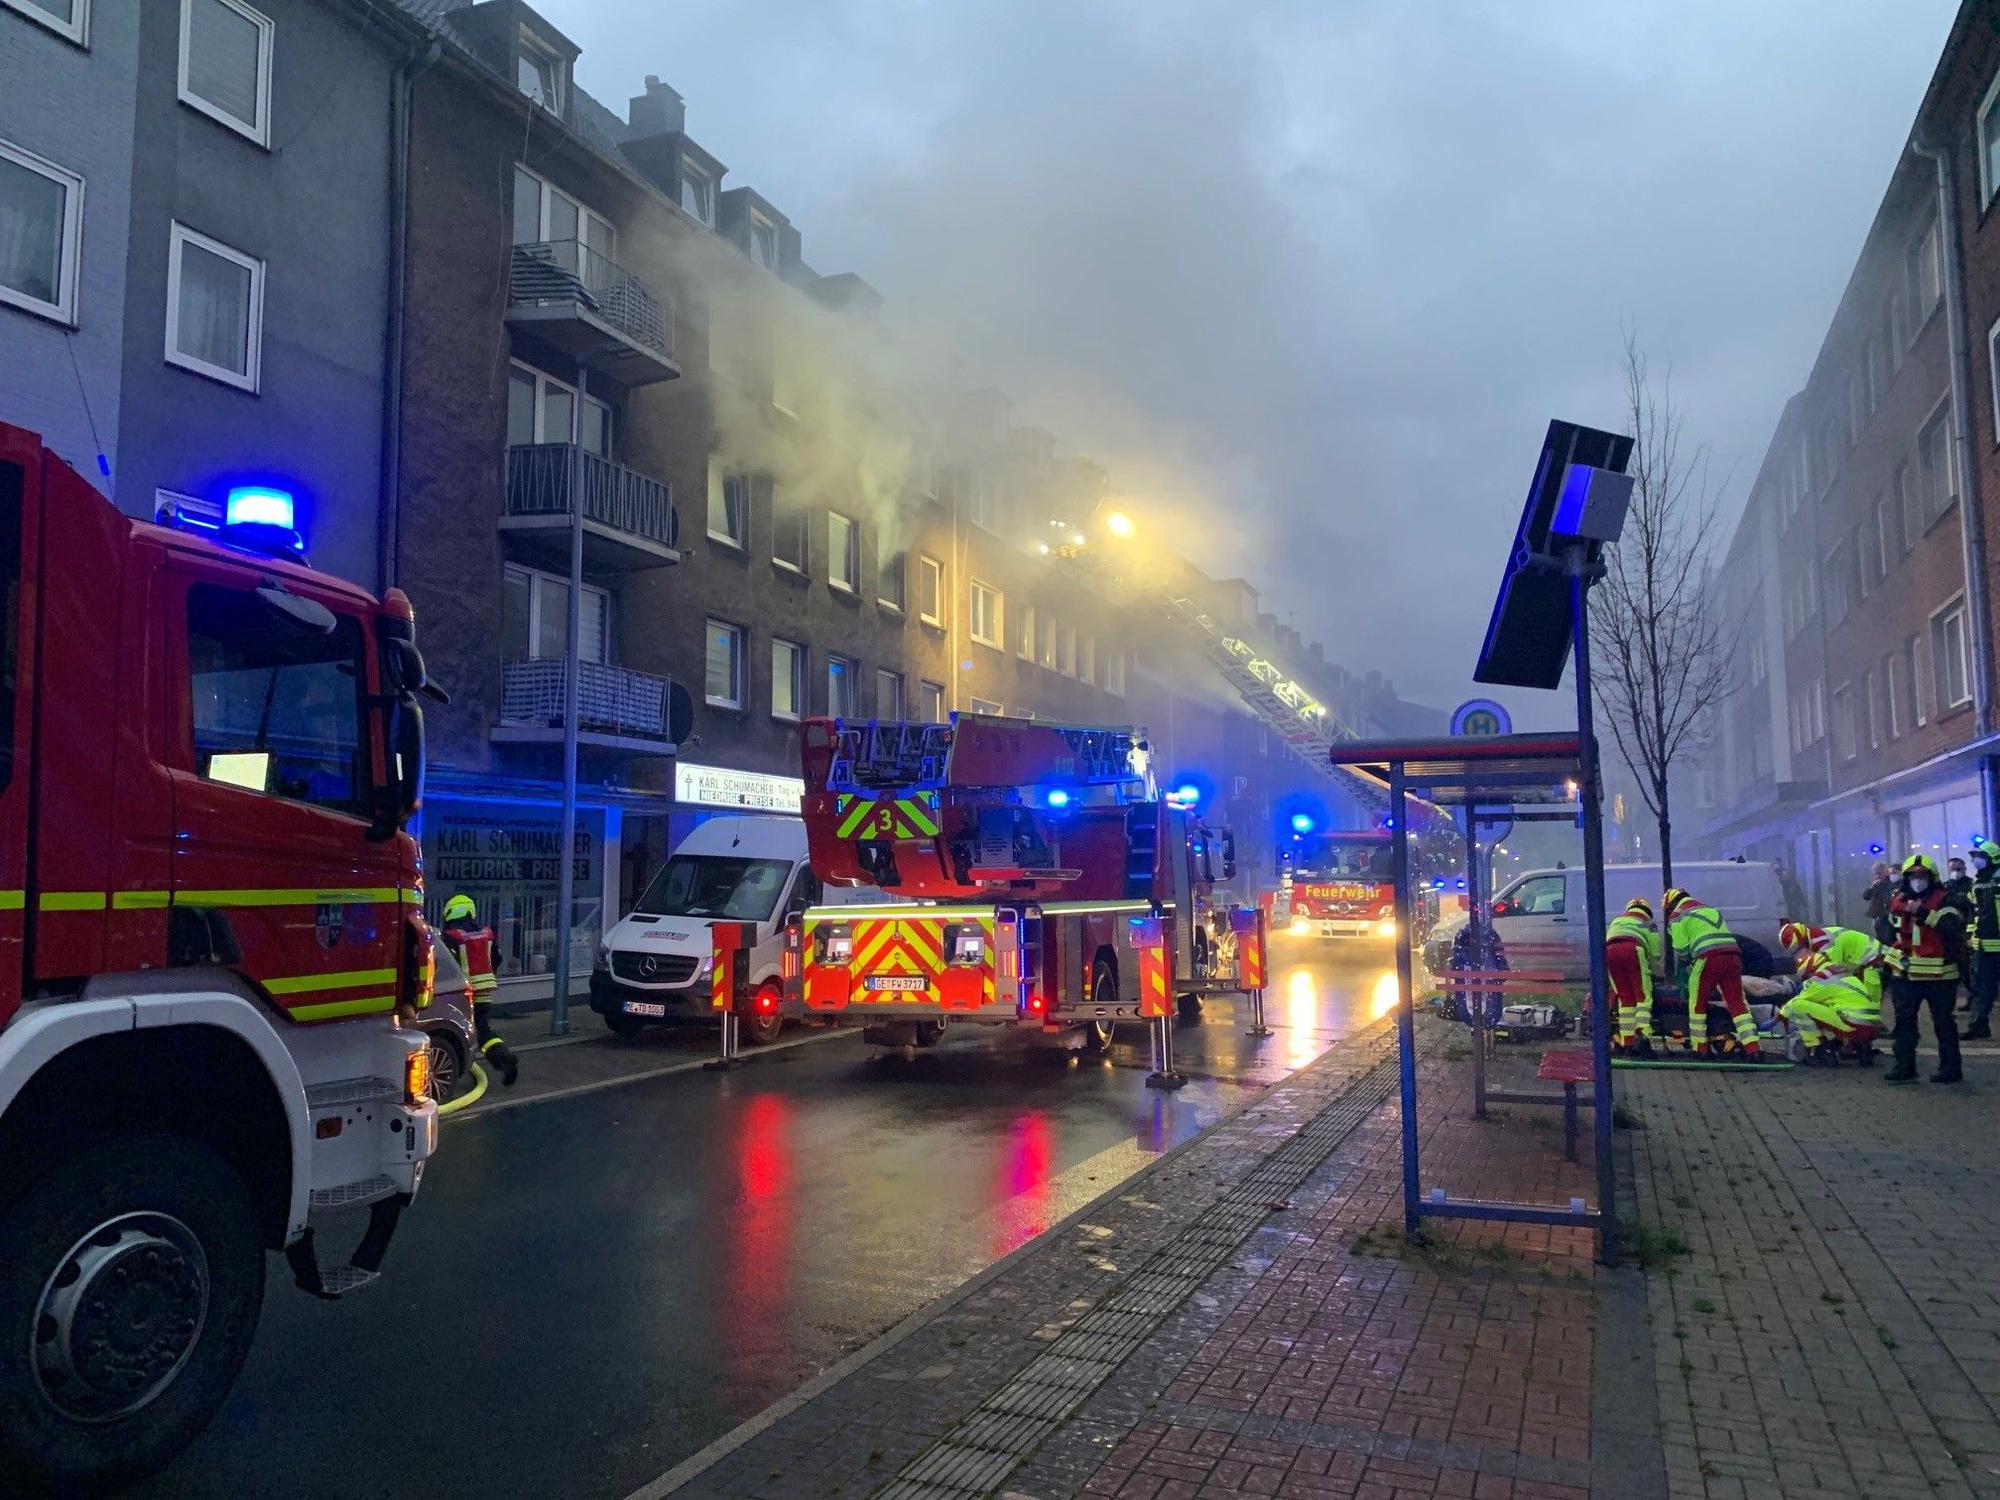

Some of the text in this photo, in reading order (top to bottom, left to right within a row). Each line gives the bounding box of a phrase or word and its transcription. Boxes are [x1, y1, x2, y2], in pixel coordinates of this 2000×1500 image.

[699, 776, 774, 795] KARL SCHUMACHER
[701, 790, 773, 807] NIEDRIGE PREISE
[880, 809, 892, 830] 3
[437, 828, 591, 855] KARL SCHUMACER
[440, 857, 587, 880] NIEDRIGE PRESE
[1305, 884, 1381, 898] Feuerwehr
[903, 979, 922, 989] 3717
